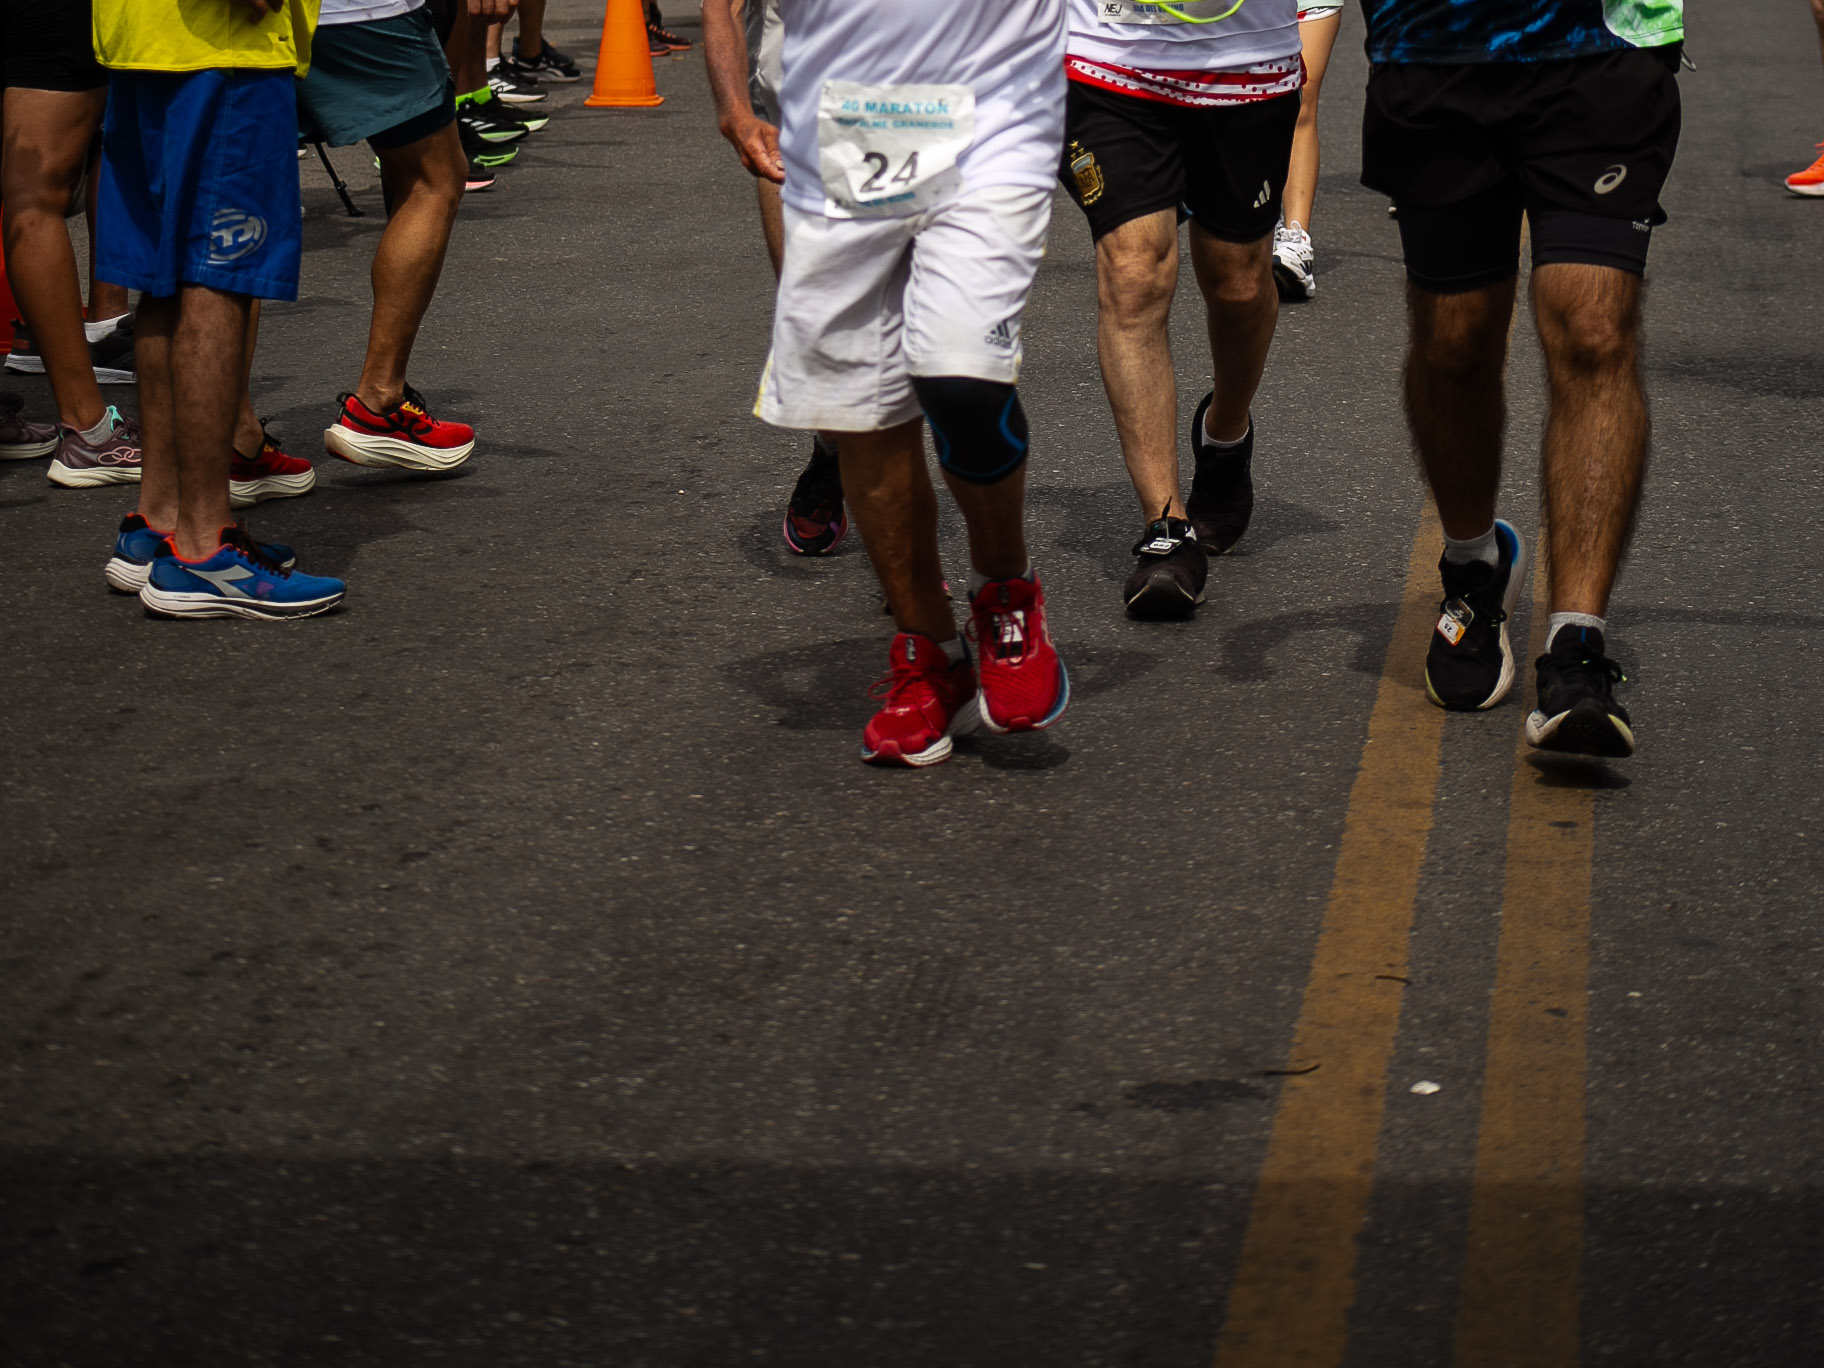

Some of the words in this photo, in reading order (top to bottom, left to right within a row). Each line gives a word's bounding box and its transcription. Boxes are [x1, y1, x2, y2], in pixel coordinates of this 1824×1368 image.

[841, 99, 860, 112] 40
[865, 101, 948, 115] MARATON
[859, 151, 919, 193] 24
